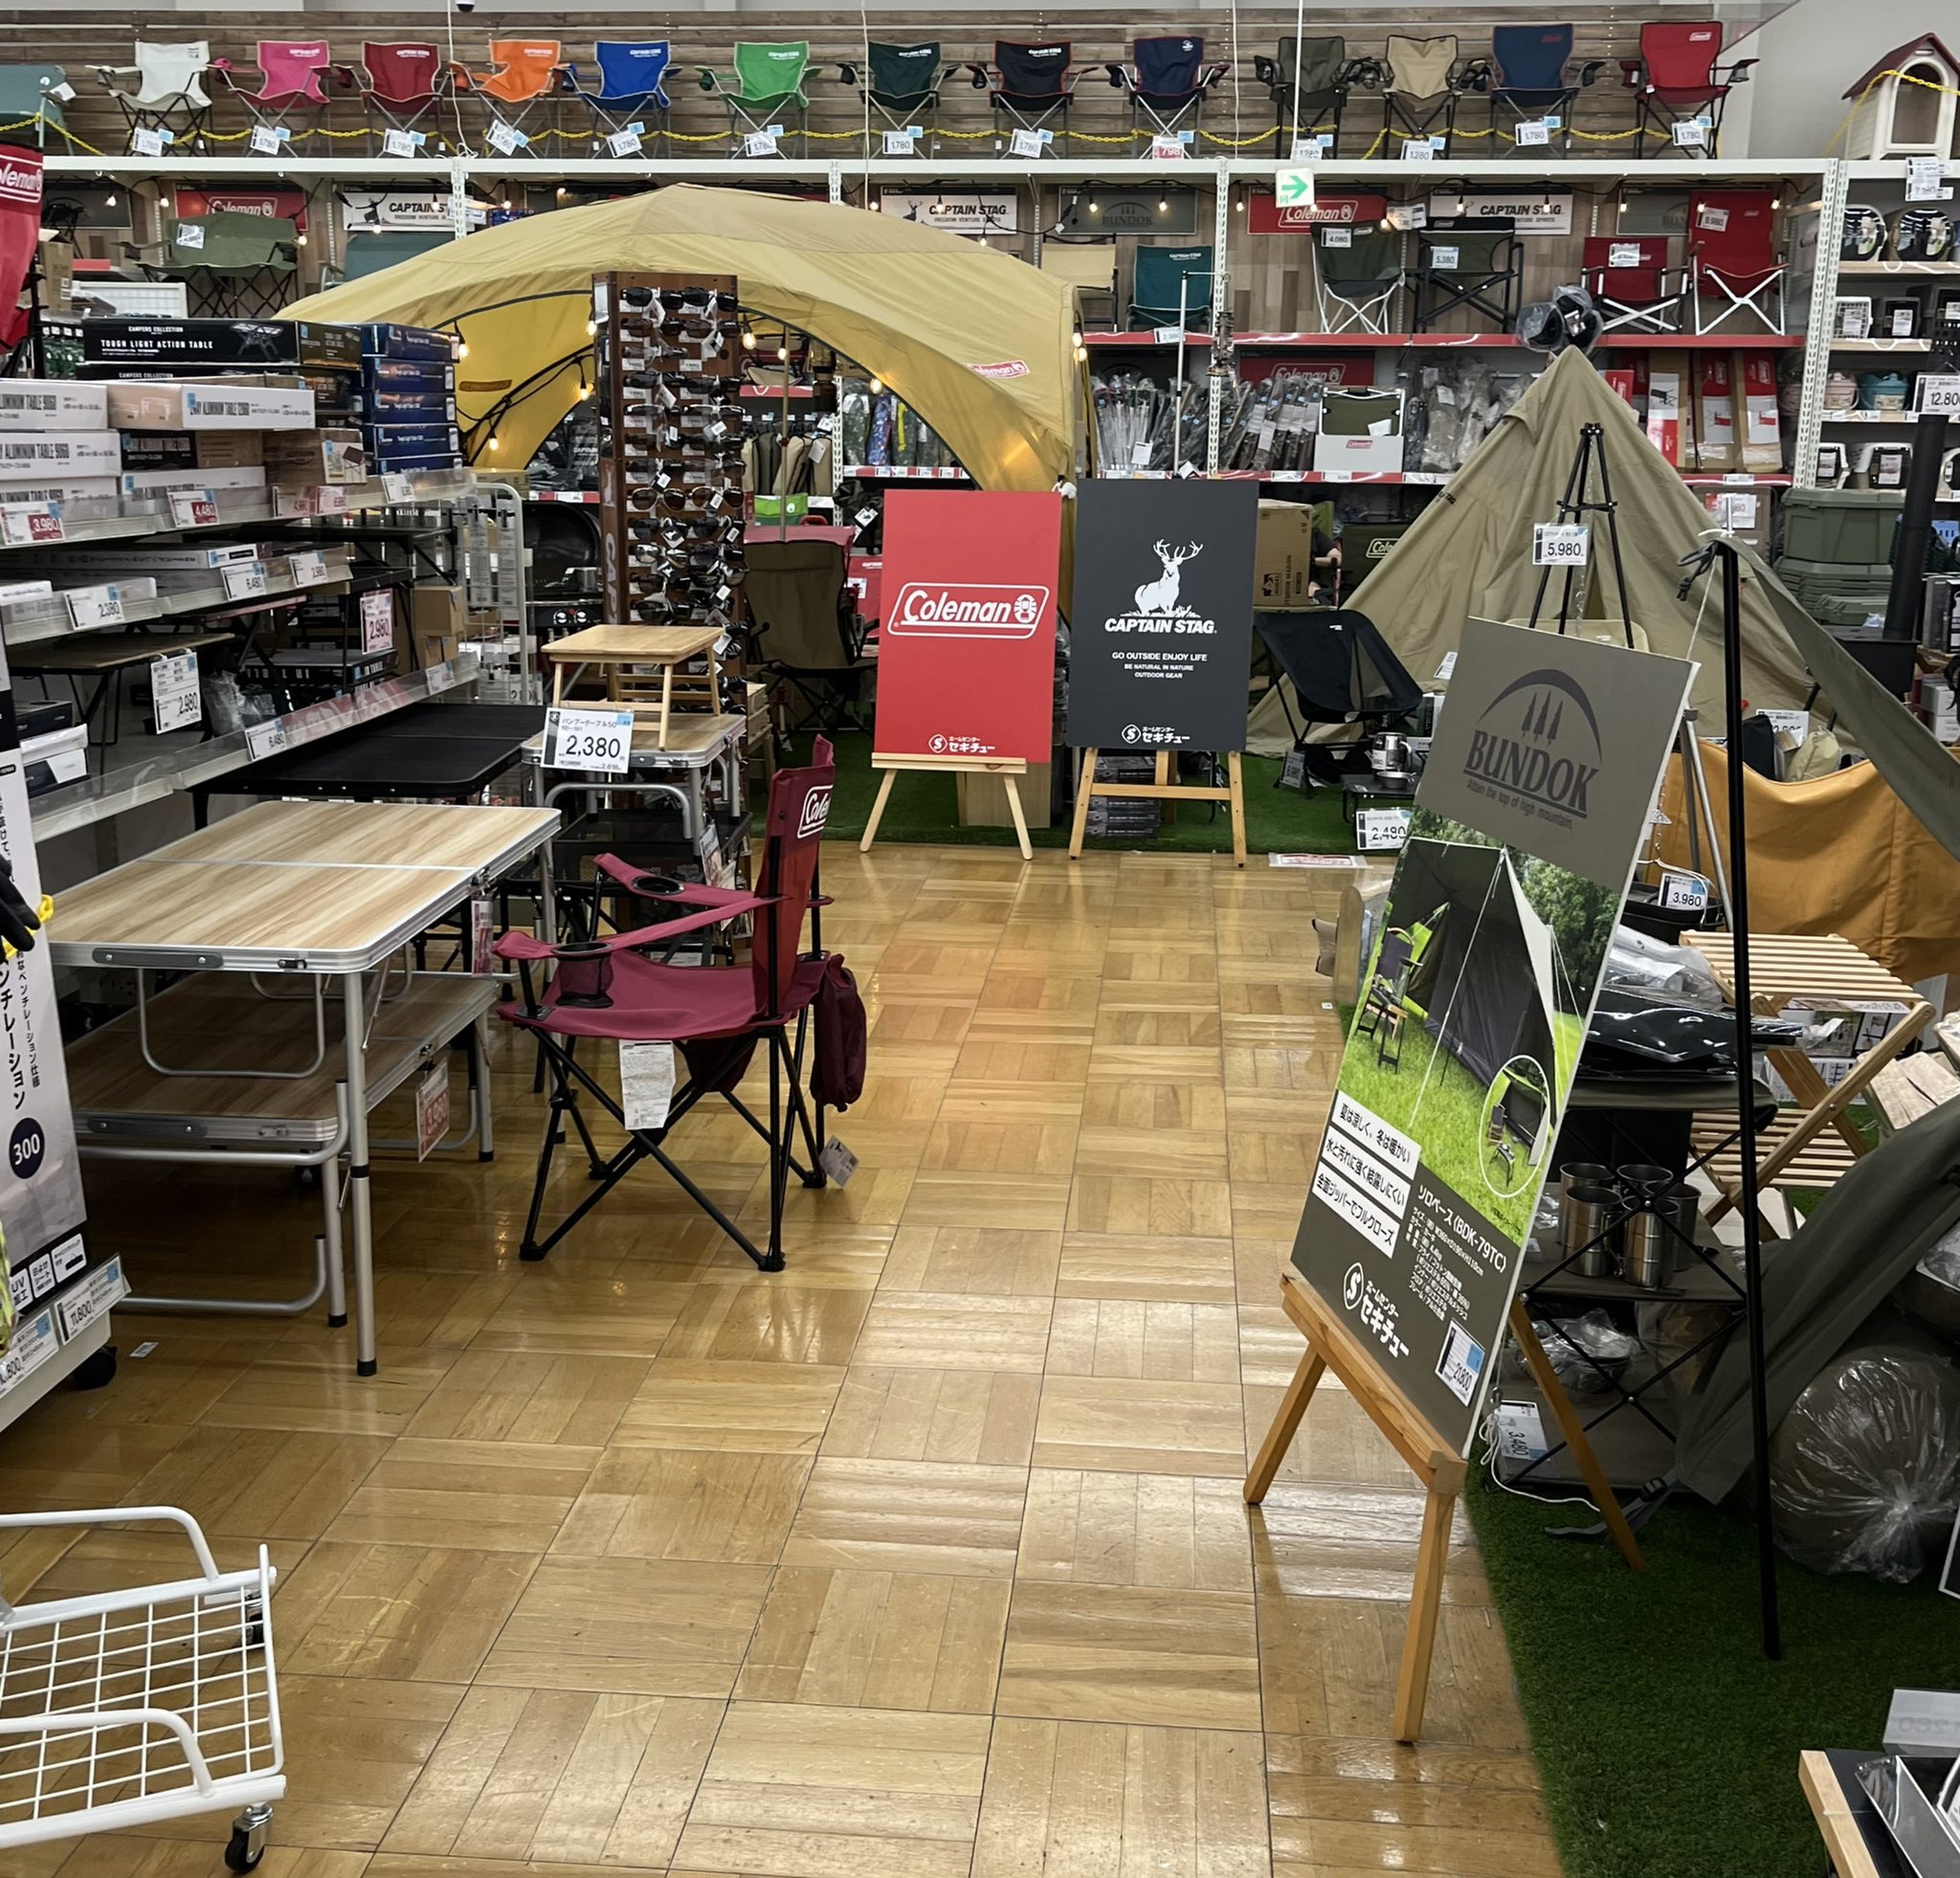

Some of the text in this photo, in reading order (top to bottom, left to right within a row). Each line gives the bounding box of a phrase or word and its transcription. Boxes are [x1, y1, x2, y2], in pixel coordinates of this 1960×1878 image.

[929, 205, 1006, 215] CPTAIN STAG
[1285, 207, 1339, 221] Coleman
[1480, 204, 1531, 215] CAPTAIN
[100, 340, 213, 351] TOUGH LIGHT ACTION TABLE
[1930, 391, 1960, 406] 12,80
[195, 503, 215, 517] 4,480
[32, 518, 58, 533] 3,980
[1548, 542, 1581, 556] 5,980
[98, 602, 120, 617] 2,380
[903, 589, 1013, 623] Coleman
[369, 617, 390, 640] 2,980
[1104, 618, 1214, 635] CAPTAIN STAG
[1126, 652, 1161, 660] OUTSIDE
[1162, 653, 1189, 661] ENJOY
[178, 691, 199, 715] 2,980
[1142, 732, 1191, 744] セキチュー
[566, 734, 621, 759] 2,380
[948, 742, 995, 753] セキチュー
[1464, 729, 1600, 813] BUNDOK
[1467, 778, 1573, 831] Attain the top of high mountain.
[1371, 826, 1406, 840] 2,480
[1672, 892, 1702, 907] 3,980
[13, 1133, 40, 1165] 300
[1316, 1173, 1394, 1246] 全面ジッパーでフルクローズ
[11, 1276, 25, 1293] UV
[1365, 1280, 1399, 1318] ホームセンター
[1360, 1293, 1410, 1358] セキチュー
[1507, 1430, 1529, 1457] 3,480
